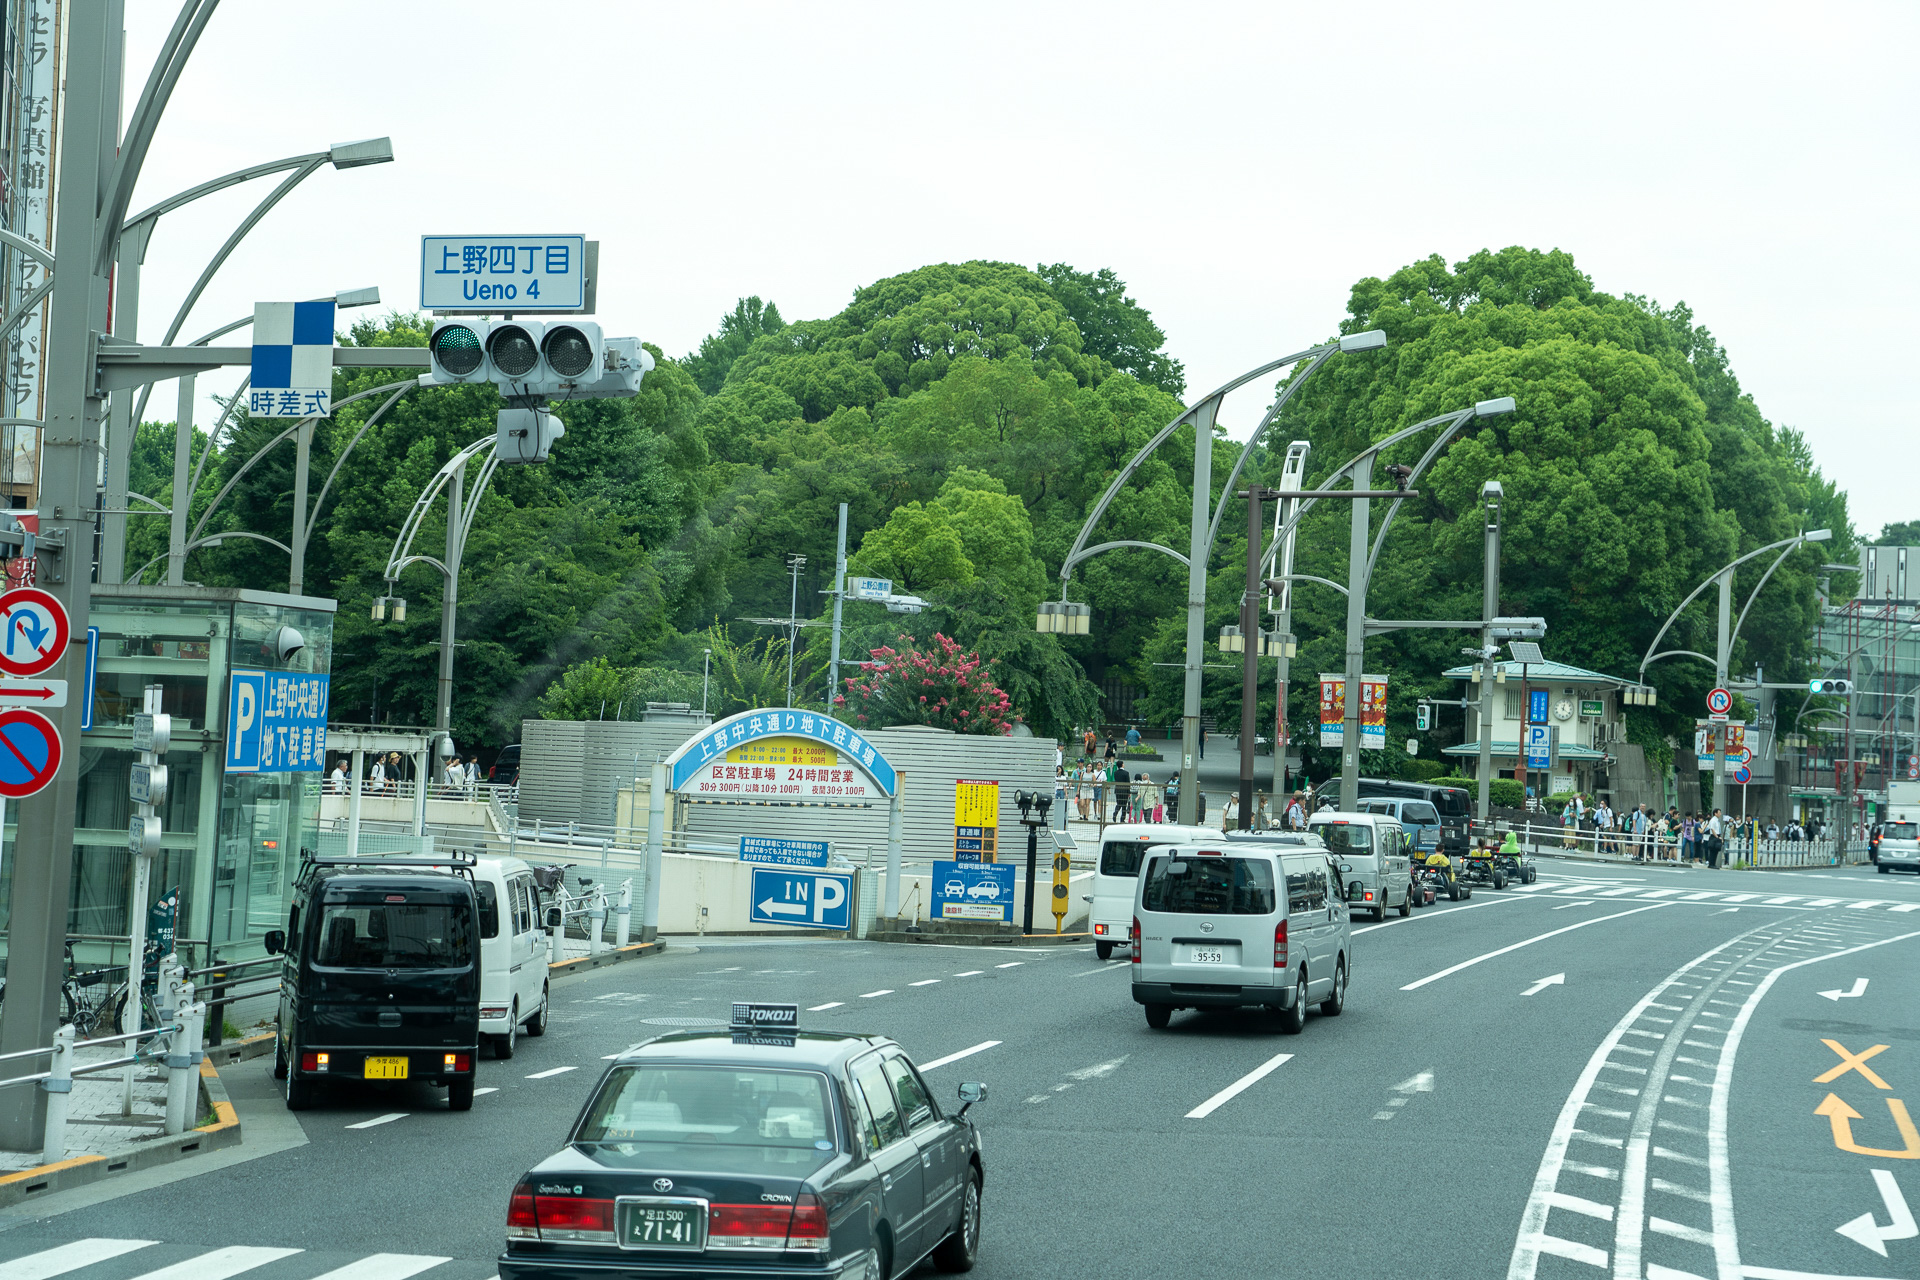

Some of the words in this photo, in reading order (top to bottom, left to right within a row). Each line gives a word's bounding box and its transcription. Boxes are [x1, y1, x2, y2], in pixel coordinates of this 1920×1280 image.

[20, 95, 49, 190] 写真館
[434, 244, 570, 275] 上野四丁目
[463, 278, 518, 301] Ueno
[526, 278, 541, 300] 4
[250, 389, 330, 417] 時差式
[860, 580, 890, 592] 上野公園前
[264, 676, 329, 719] 上野中央通り
[234, 682, 256, 760] P
[1362, 726, 1384, 734] ティス展
[1532, 728, 1545, 744] P
[261, 724, 325, 767] 地下駐車場
[699, 712, 877, 768] 上野中央通り地下駐車場
[792, 747, 804, 755] 最大
[1531, 748, 1547, 756] 京成
[810, 756, 826, 764] 500円
[711, 765, 776, 781] 区営駐車場
[787, 767, 854, 783] 24時間営業
[699, 782, 718, 792] 30分
[844, 785, 865, 796] 100円
[959, 827, 981, 836] 普通車
[784, 880, 808, 902] IN
[813, 877, 846, 923] P
[1197, 952, 1221, 963] 95-59
[749, 1009, 796, 1021] TOKOJI
[609, 1128, 635, 1138] 831
[760, 1193, 792, 1203] CROWN
[646, 1209, 665, 1221] 足立
[666, 1210, 684, 1221] 500
[633, 1225, 641, 1236] え
[643, 1221, 691, 1242] 71-41
